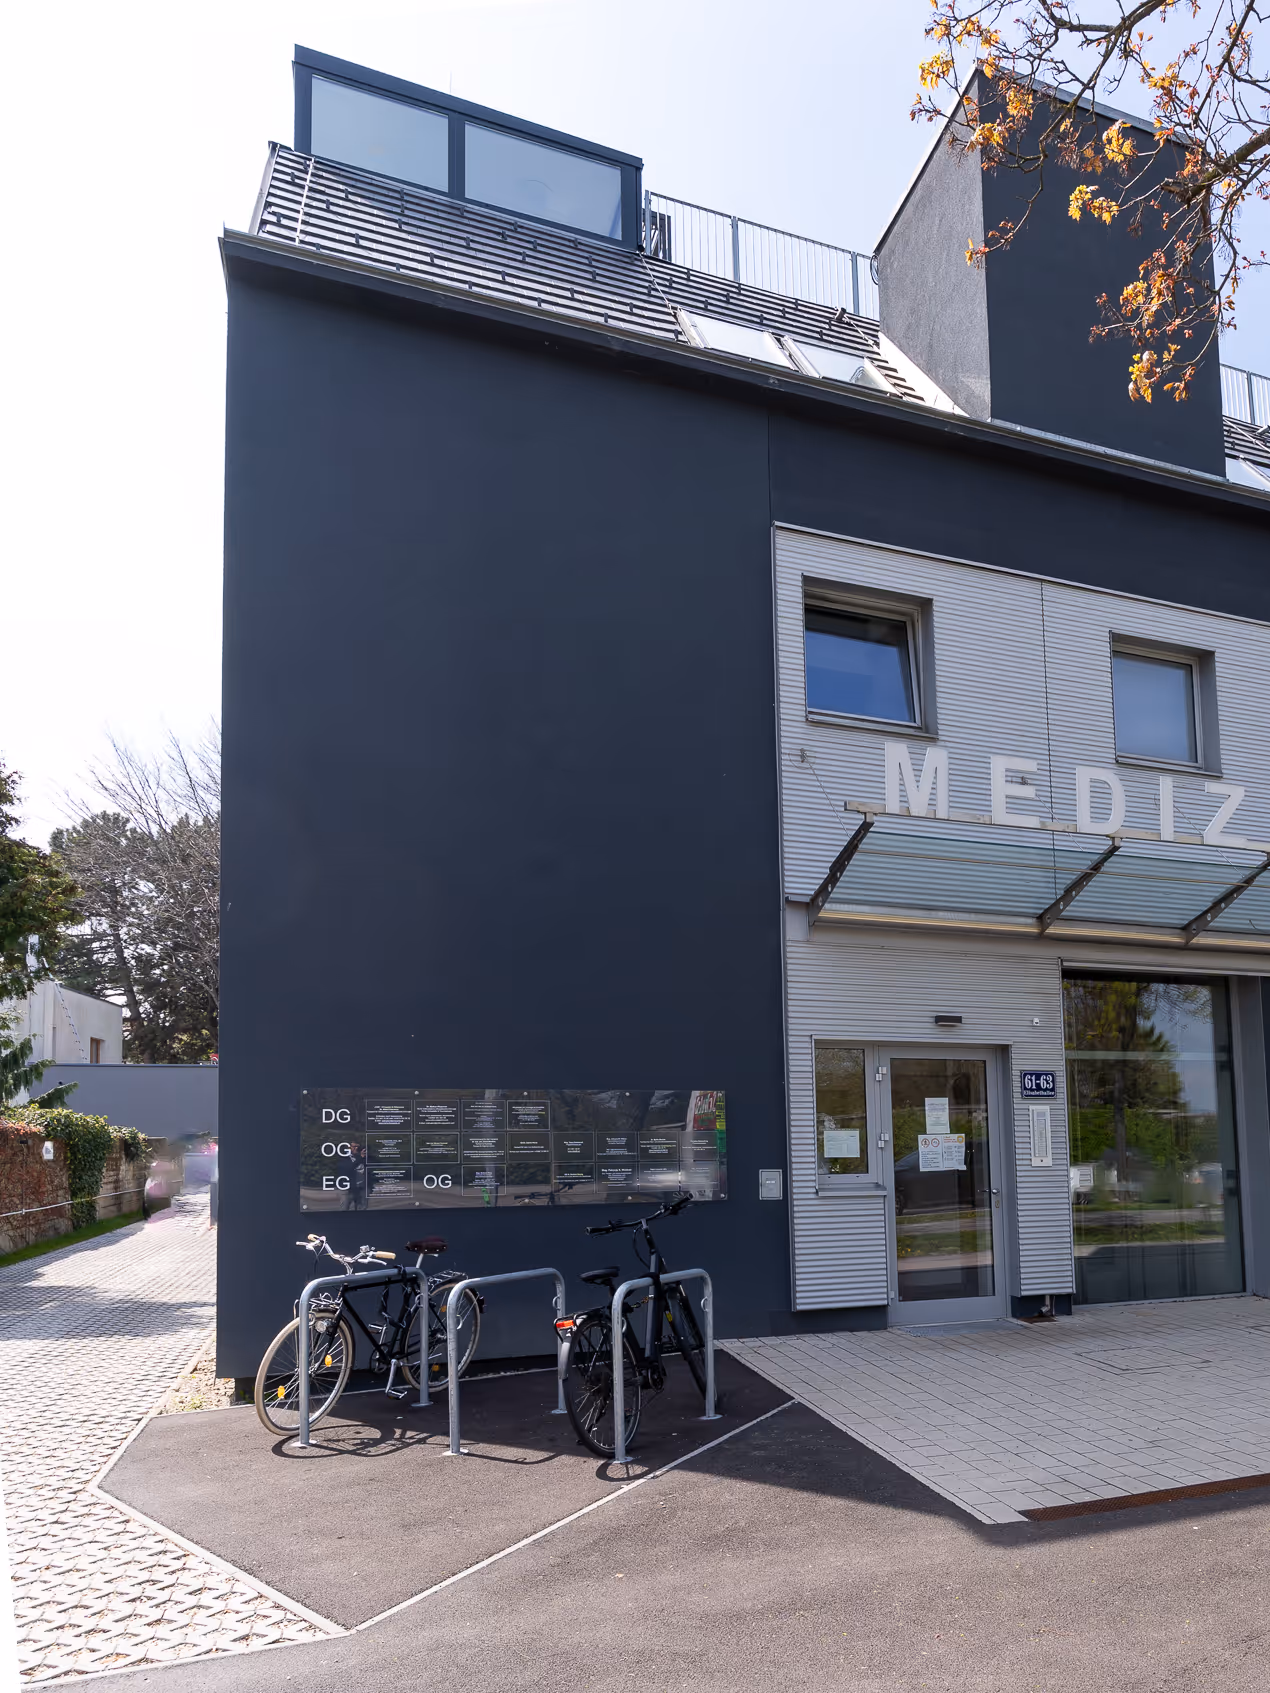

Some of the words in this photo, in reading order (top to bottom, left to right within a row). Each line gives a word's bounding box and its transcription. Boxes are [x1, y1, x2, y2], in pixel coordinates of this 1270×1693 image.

[1024, 1074, 1053, 1089] 61-63
[322, 1108, 350, 1123] DG
[321, 1142, 351, 1157] OG
[322, 1175, 350, 1191] EG
[423, 1174, 452, 1189] OG
